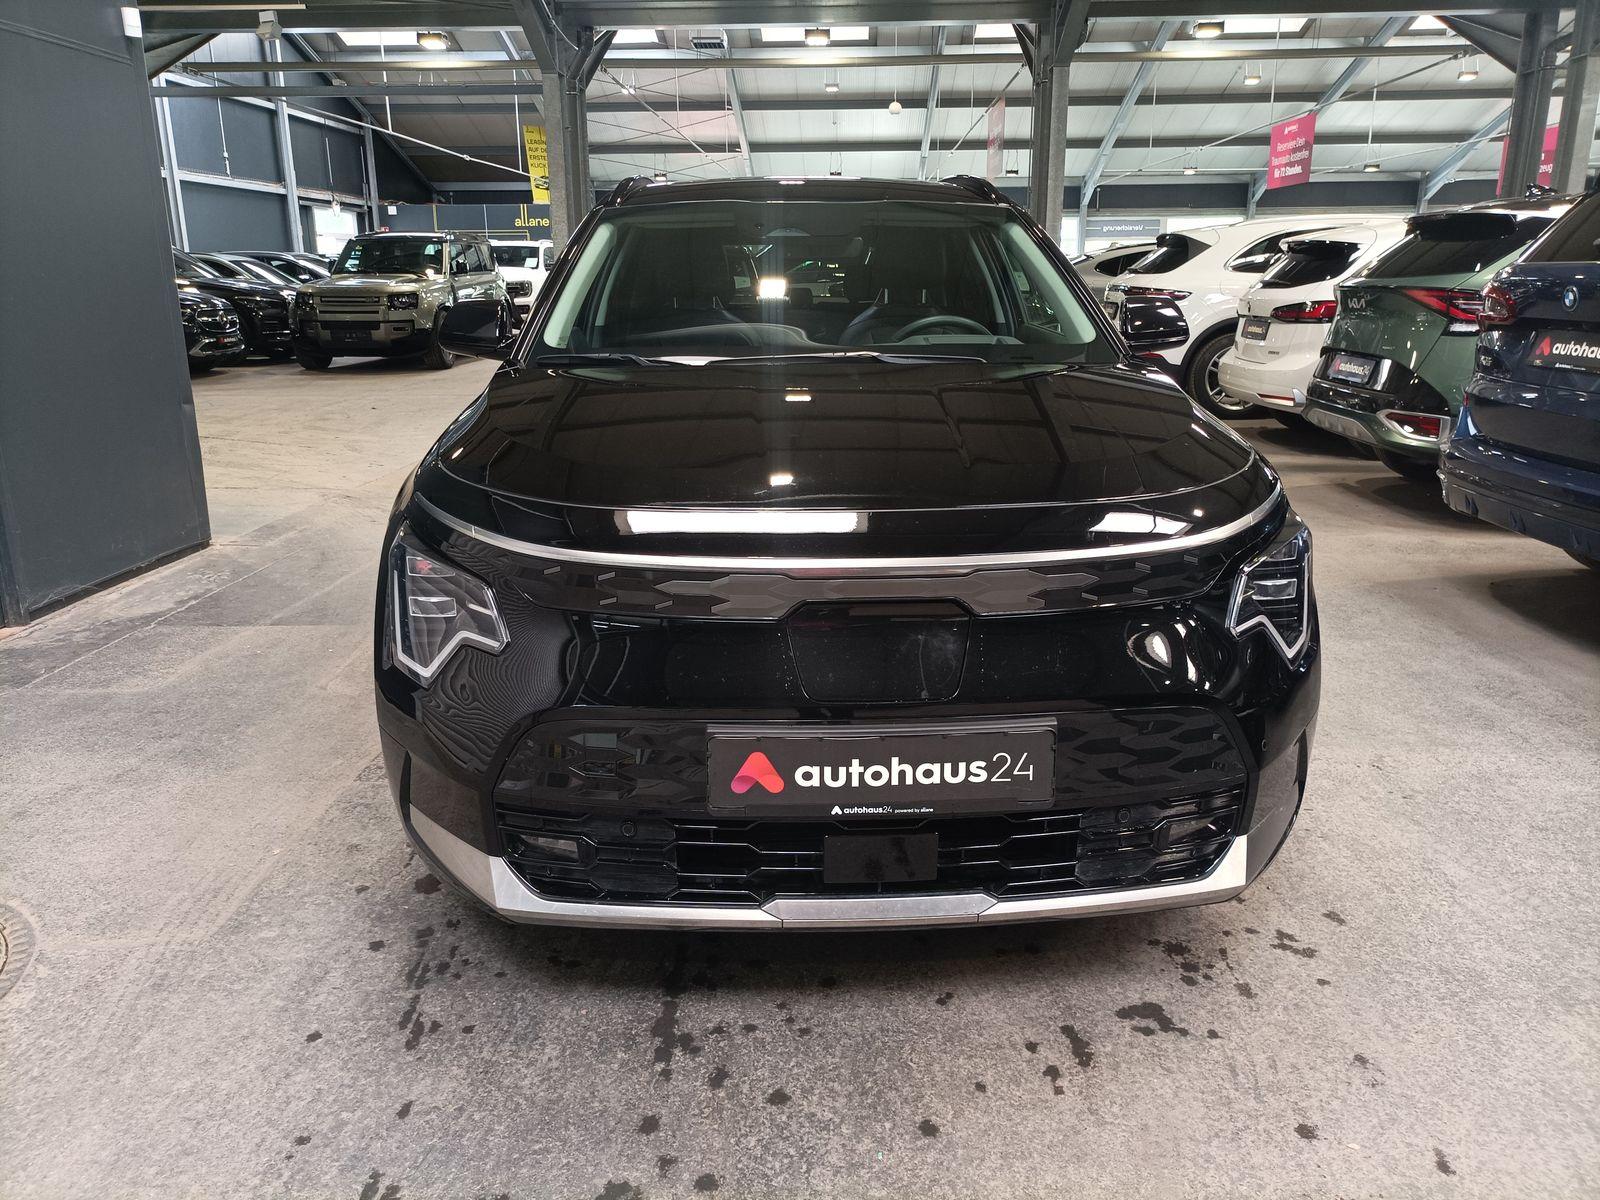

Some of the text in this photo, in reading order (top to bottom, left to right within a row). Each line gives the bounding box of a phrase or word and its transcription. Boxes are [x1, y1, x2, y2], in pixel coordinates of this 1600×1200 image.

[1539, 164, 1553, 173] zeug
[1339, 362, 1370, 375] autohaus24
[794, 752, 1034, 788] autohaus24
[843, 806, 893, 814] autohaus24
